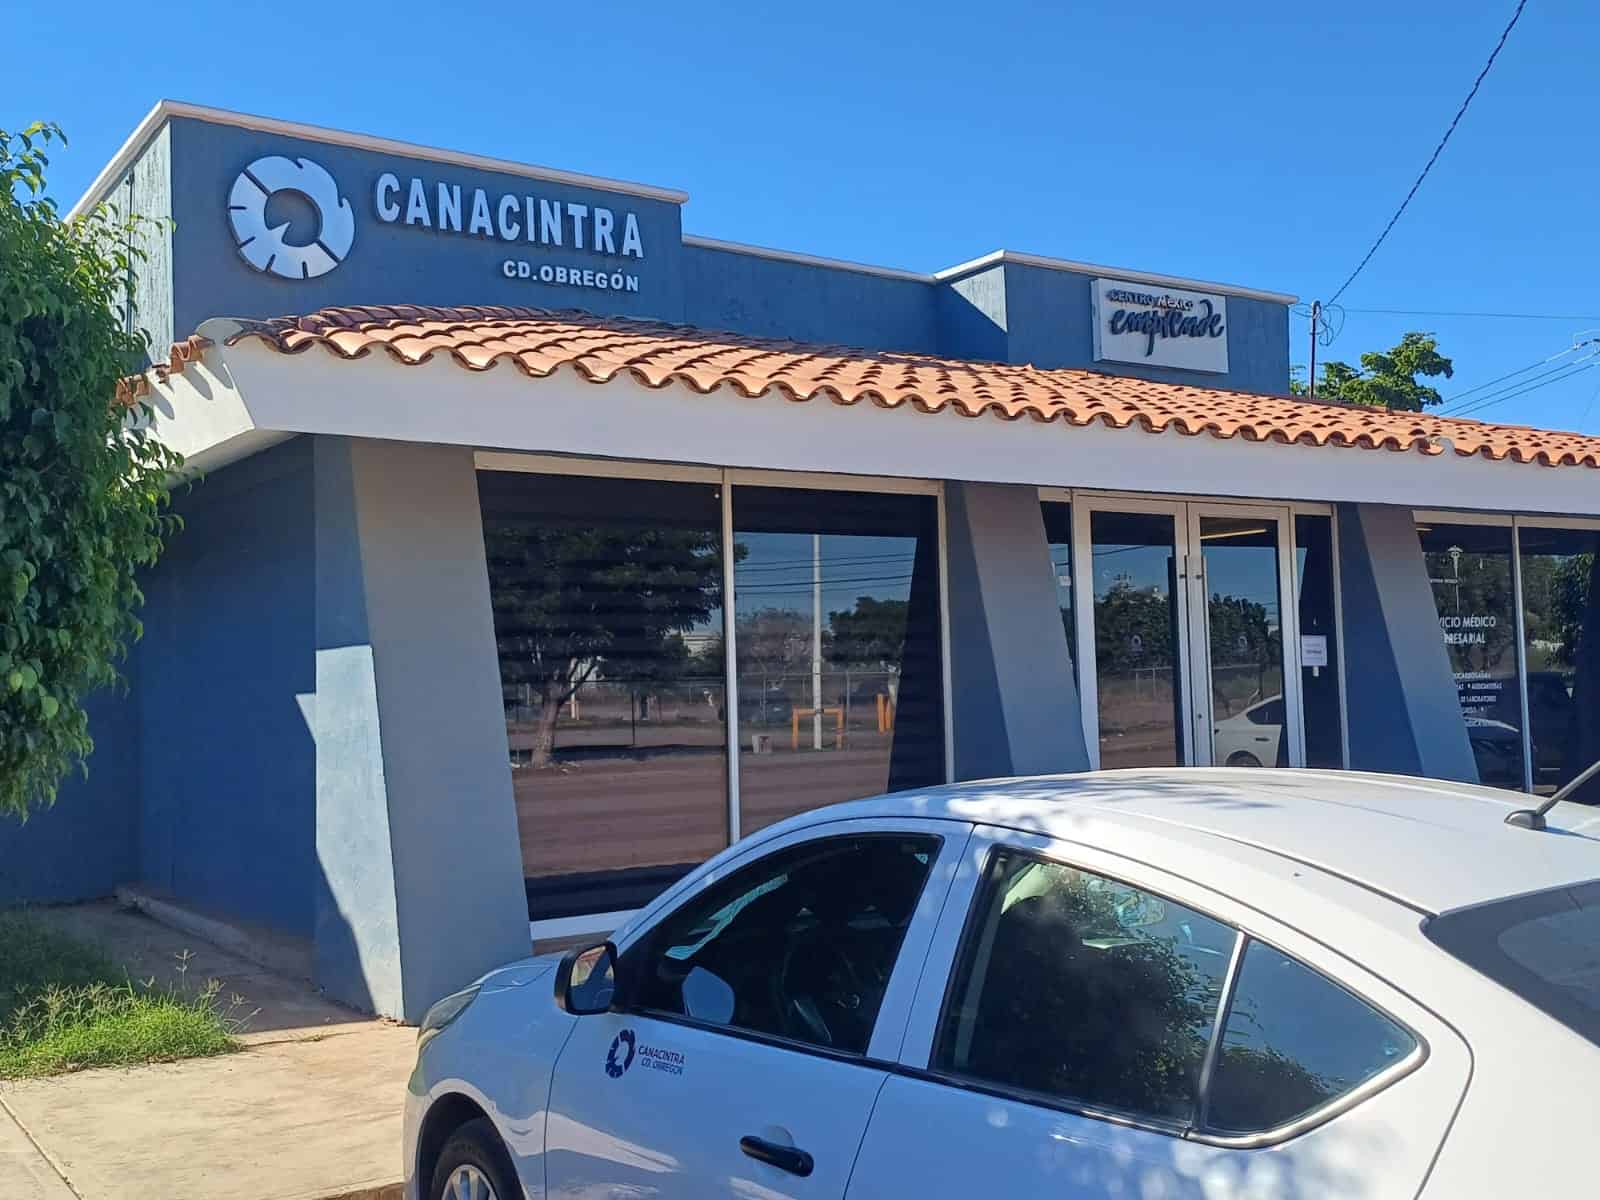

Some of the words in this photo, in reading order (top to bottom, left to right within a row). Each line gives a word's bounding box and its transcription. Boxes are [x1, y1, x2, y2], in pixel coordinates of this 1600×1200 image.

[375, 172, 645, 259] CANACINTRA
[1109, 288, 1153, 306] CENTRO
[1462, 614, 1496, 628] MÉDICO
[638, 1045, 684, 1065] CANACINTRA
